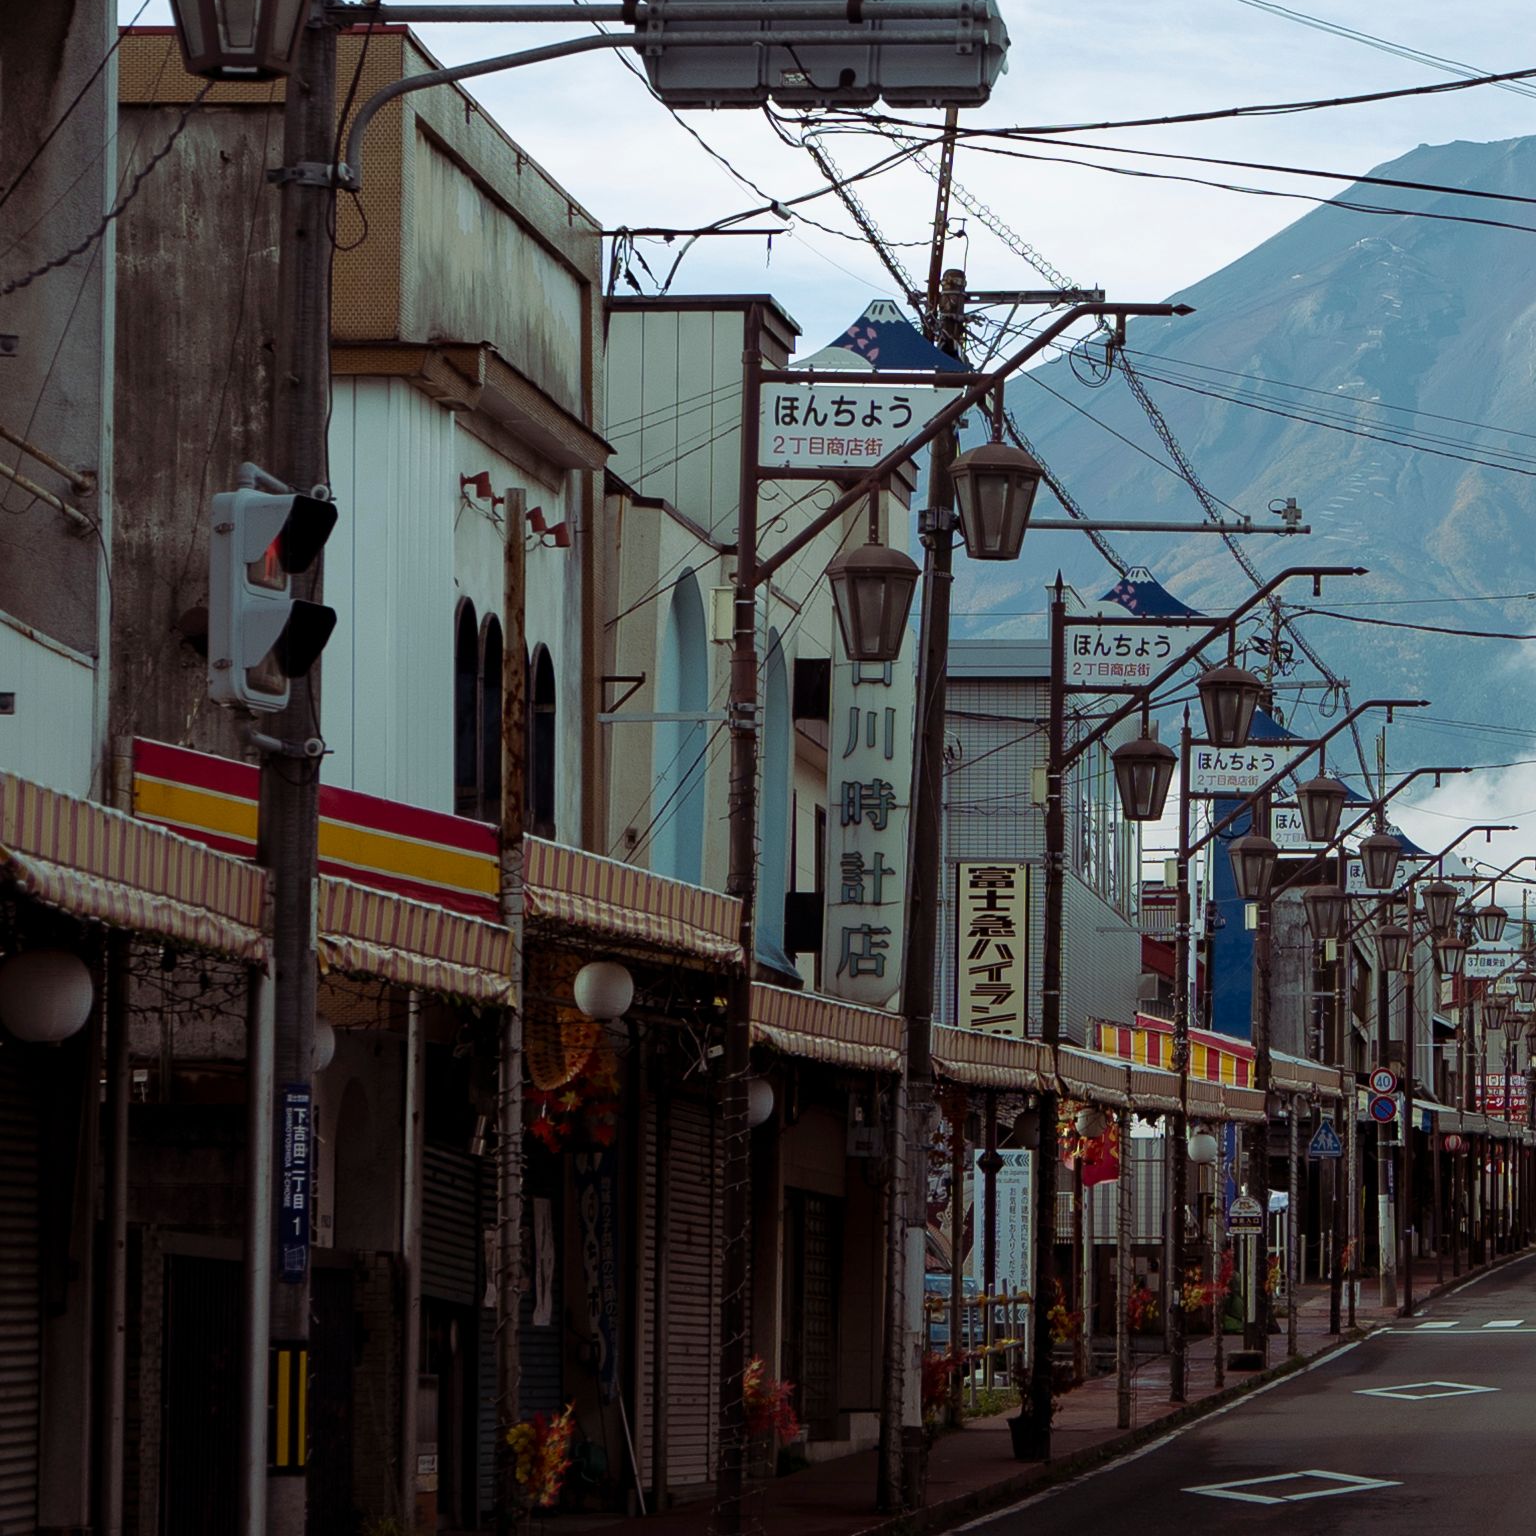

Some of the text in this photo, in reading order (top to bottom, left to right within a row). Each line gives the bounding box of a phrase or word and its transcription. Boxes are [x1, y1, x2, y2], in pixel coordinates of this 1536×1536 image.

[774, 395, 913, 428] ほんちょう
[773, 435, 884, 457] 2丁目商店街
[1073, 633, 1171, 658] ほんちょう
[1072, 662, 1150, 677] 2丁目商店街
[1197, 752, 1276, 771] ほんちょう
[967, 867, 1017, 1036] 富士急ハイラン
[1376, 1075, 1391, 1087] 40
[291, 1108, 307, 1209] 下吉田二丁目
[291, 1216, 301, 1236] 1
